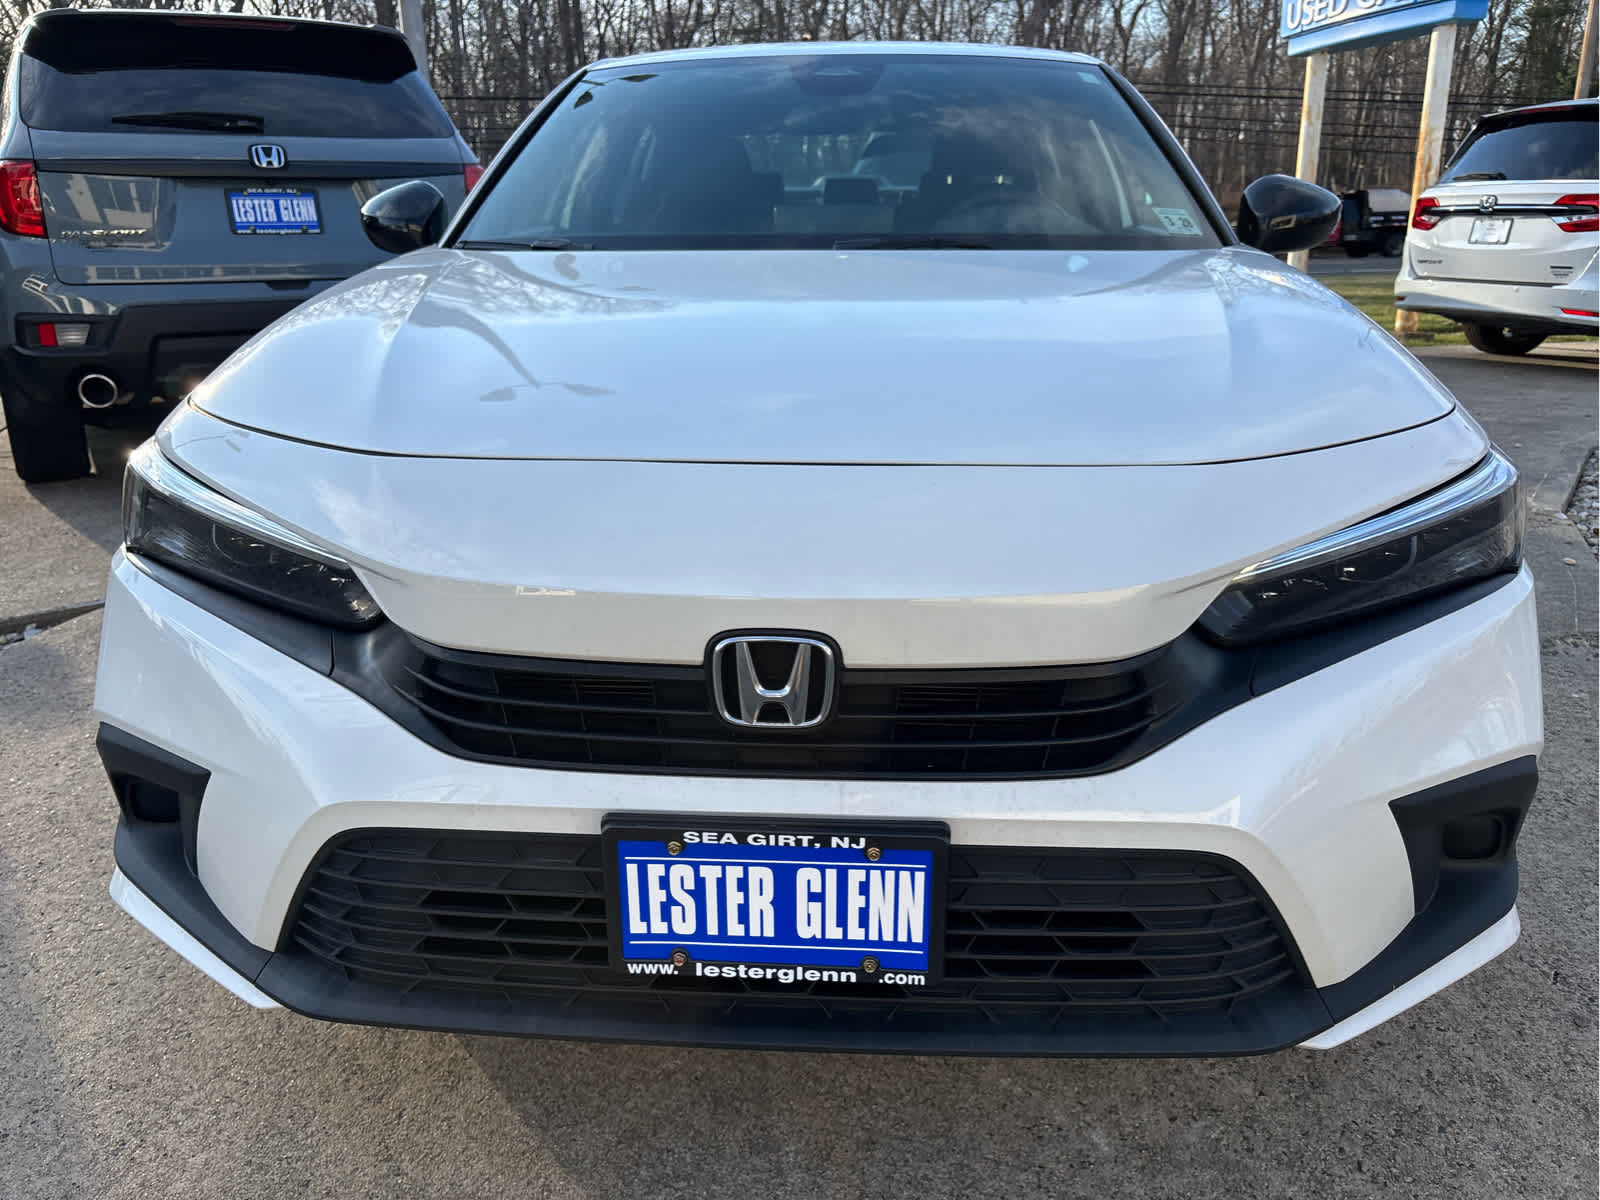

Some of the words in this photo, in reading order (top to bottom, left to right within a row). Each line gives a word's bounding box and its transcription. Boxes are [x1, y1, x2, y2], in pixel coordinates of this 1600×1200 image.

[1287, 0, 1348, 29] USED
[231, 199, 278, 222] LESTER
[279, 199, 318, 222] GLENN
[683, 831, 739, 846] SEA
[746, 833, 821, 849] GIRT,
[831, 836, 867, 850] NJ
[626, 863, 775, 938] LESTER
[796, 867, 926, 943] GLENN
[627, 962, 680, 975] www.
[696, 962, 857, 983] lesterglenn
[878, 971, 926, 985] .com
